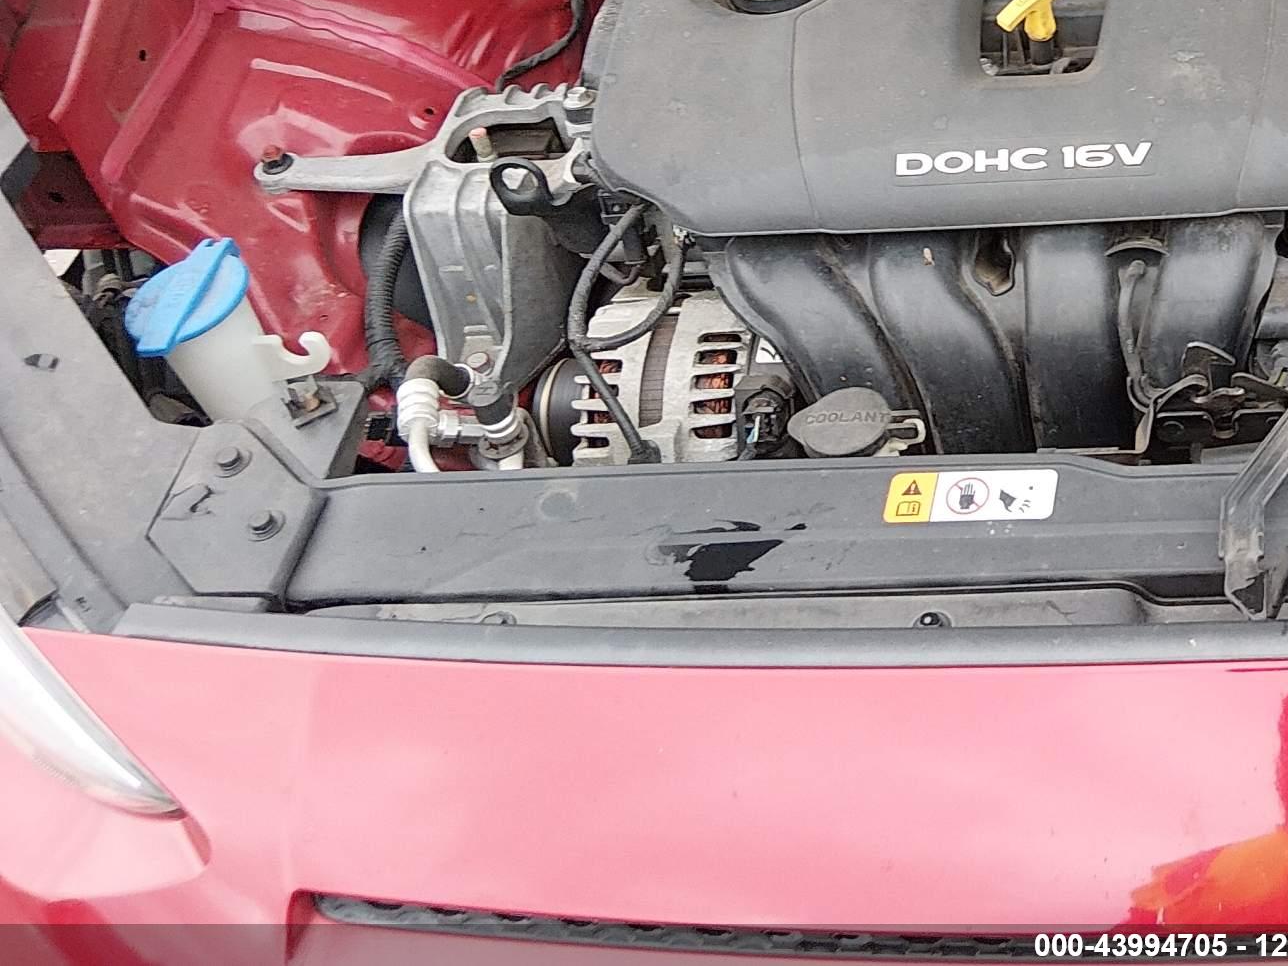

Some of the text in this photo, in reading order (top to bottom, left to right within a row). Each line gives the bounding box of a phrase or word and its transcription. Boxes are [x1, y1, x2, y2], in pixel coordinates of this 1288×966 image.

[895, 141, 1153, 177] DOHC 16V
[804, 410, 891, 425] COOLANT
